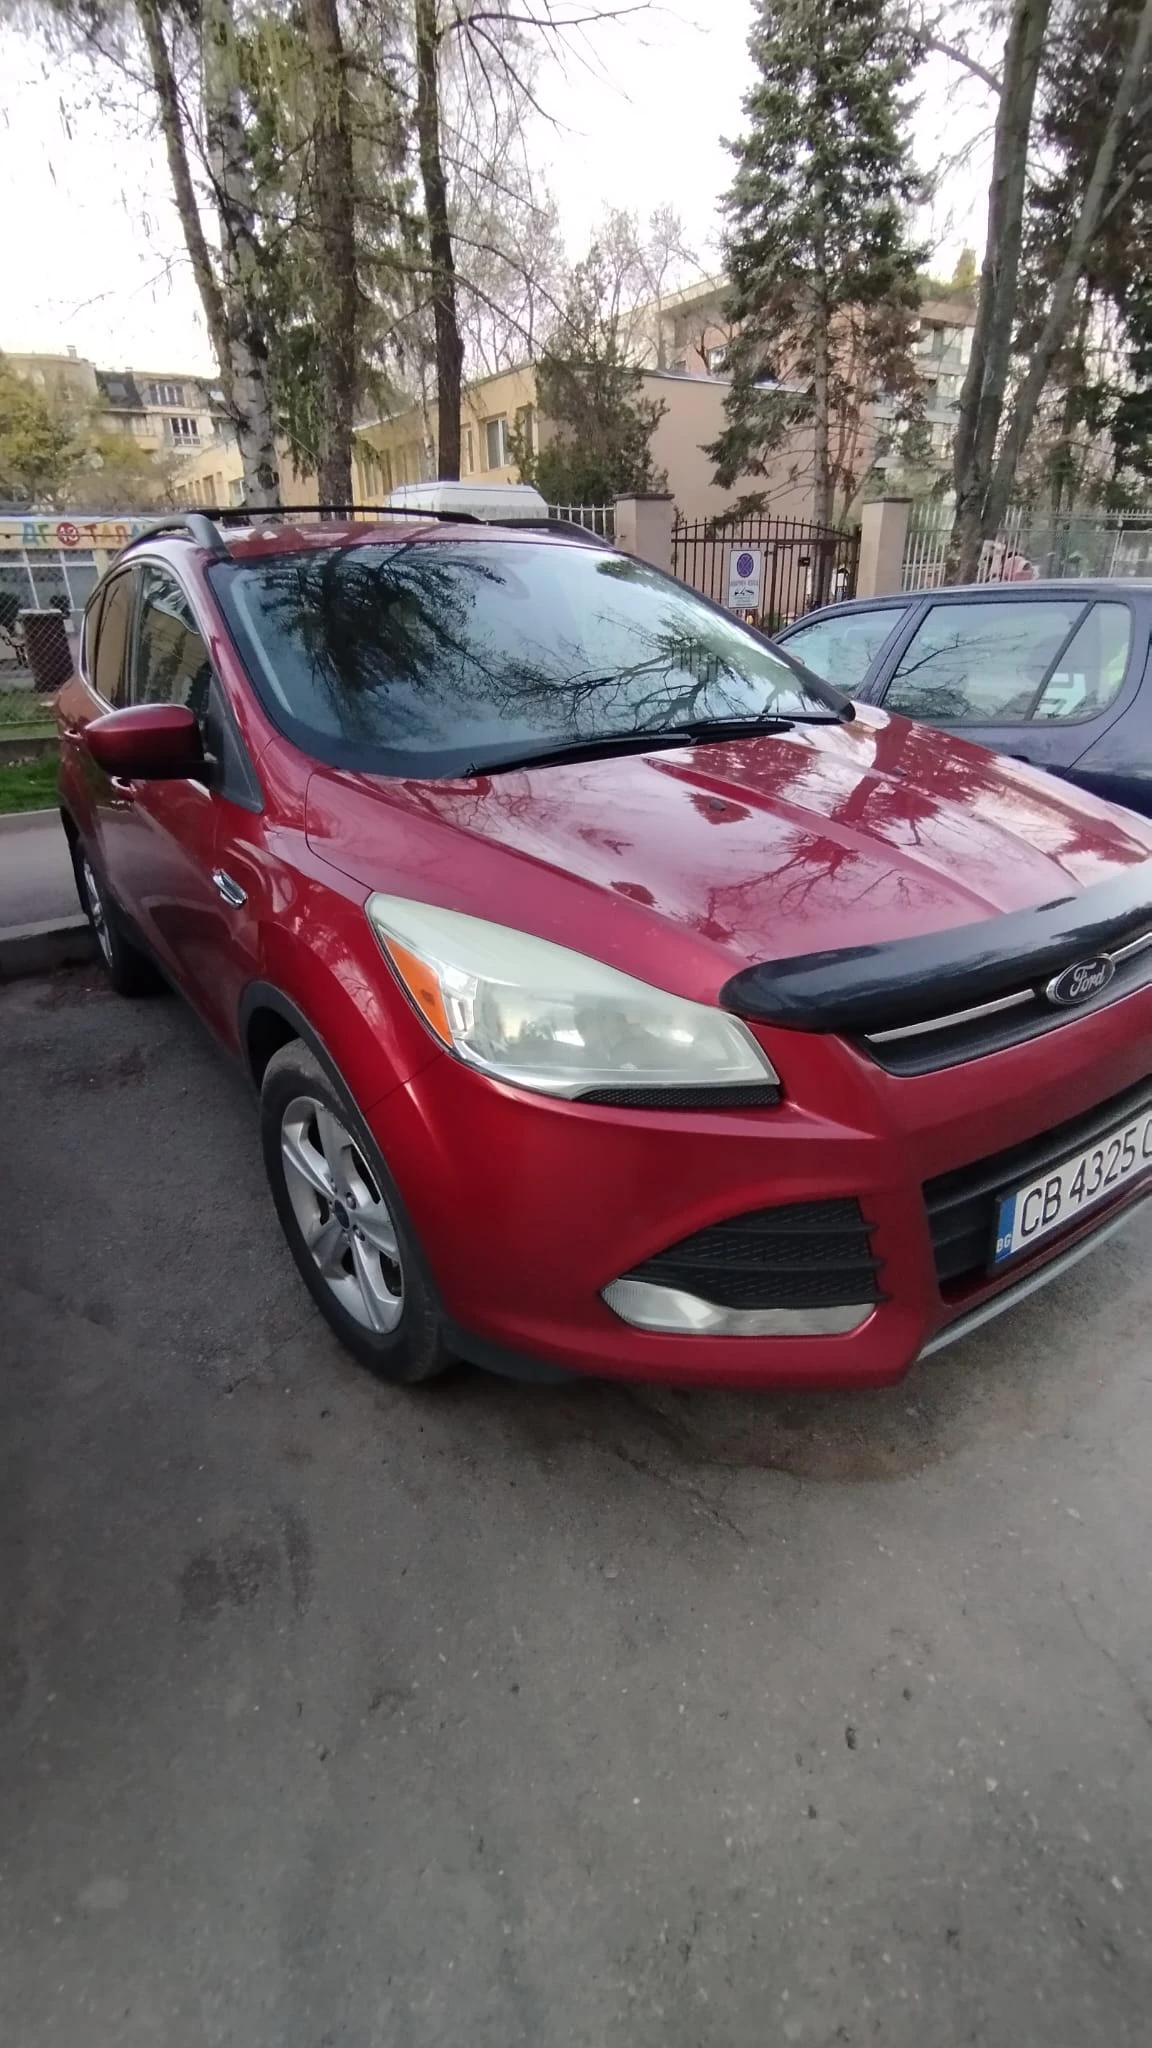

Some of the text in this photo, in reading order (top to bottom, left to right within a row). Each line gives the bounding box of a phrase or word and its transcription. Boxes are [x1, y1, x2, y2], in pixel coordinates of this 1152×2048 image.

[84, 523, 146, 544] ТАЛА
[1070, 962, 1106, 997] Ford
[1069, 1127, 1137, 1203] 4325
[996, 1233, 1011, 1253] BG
